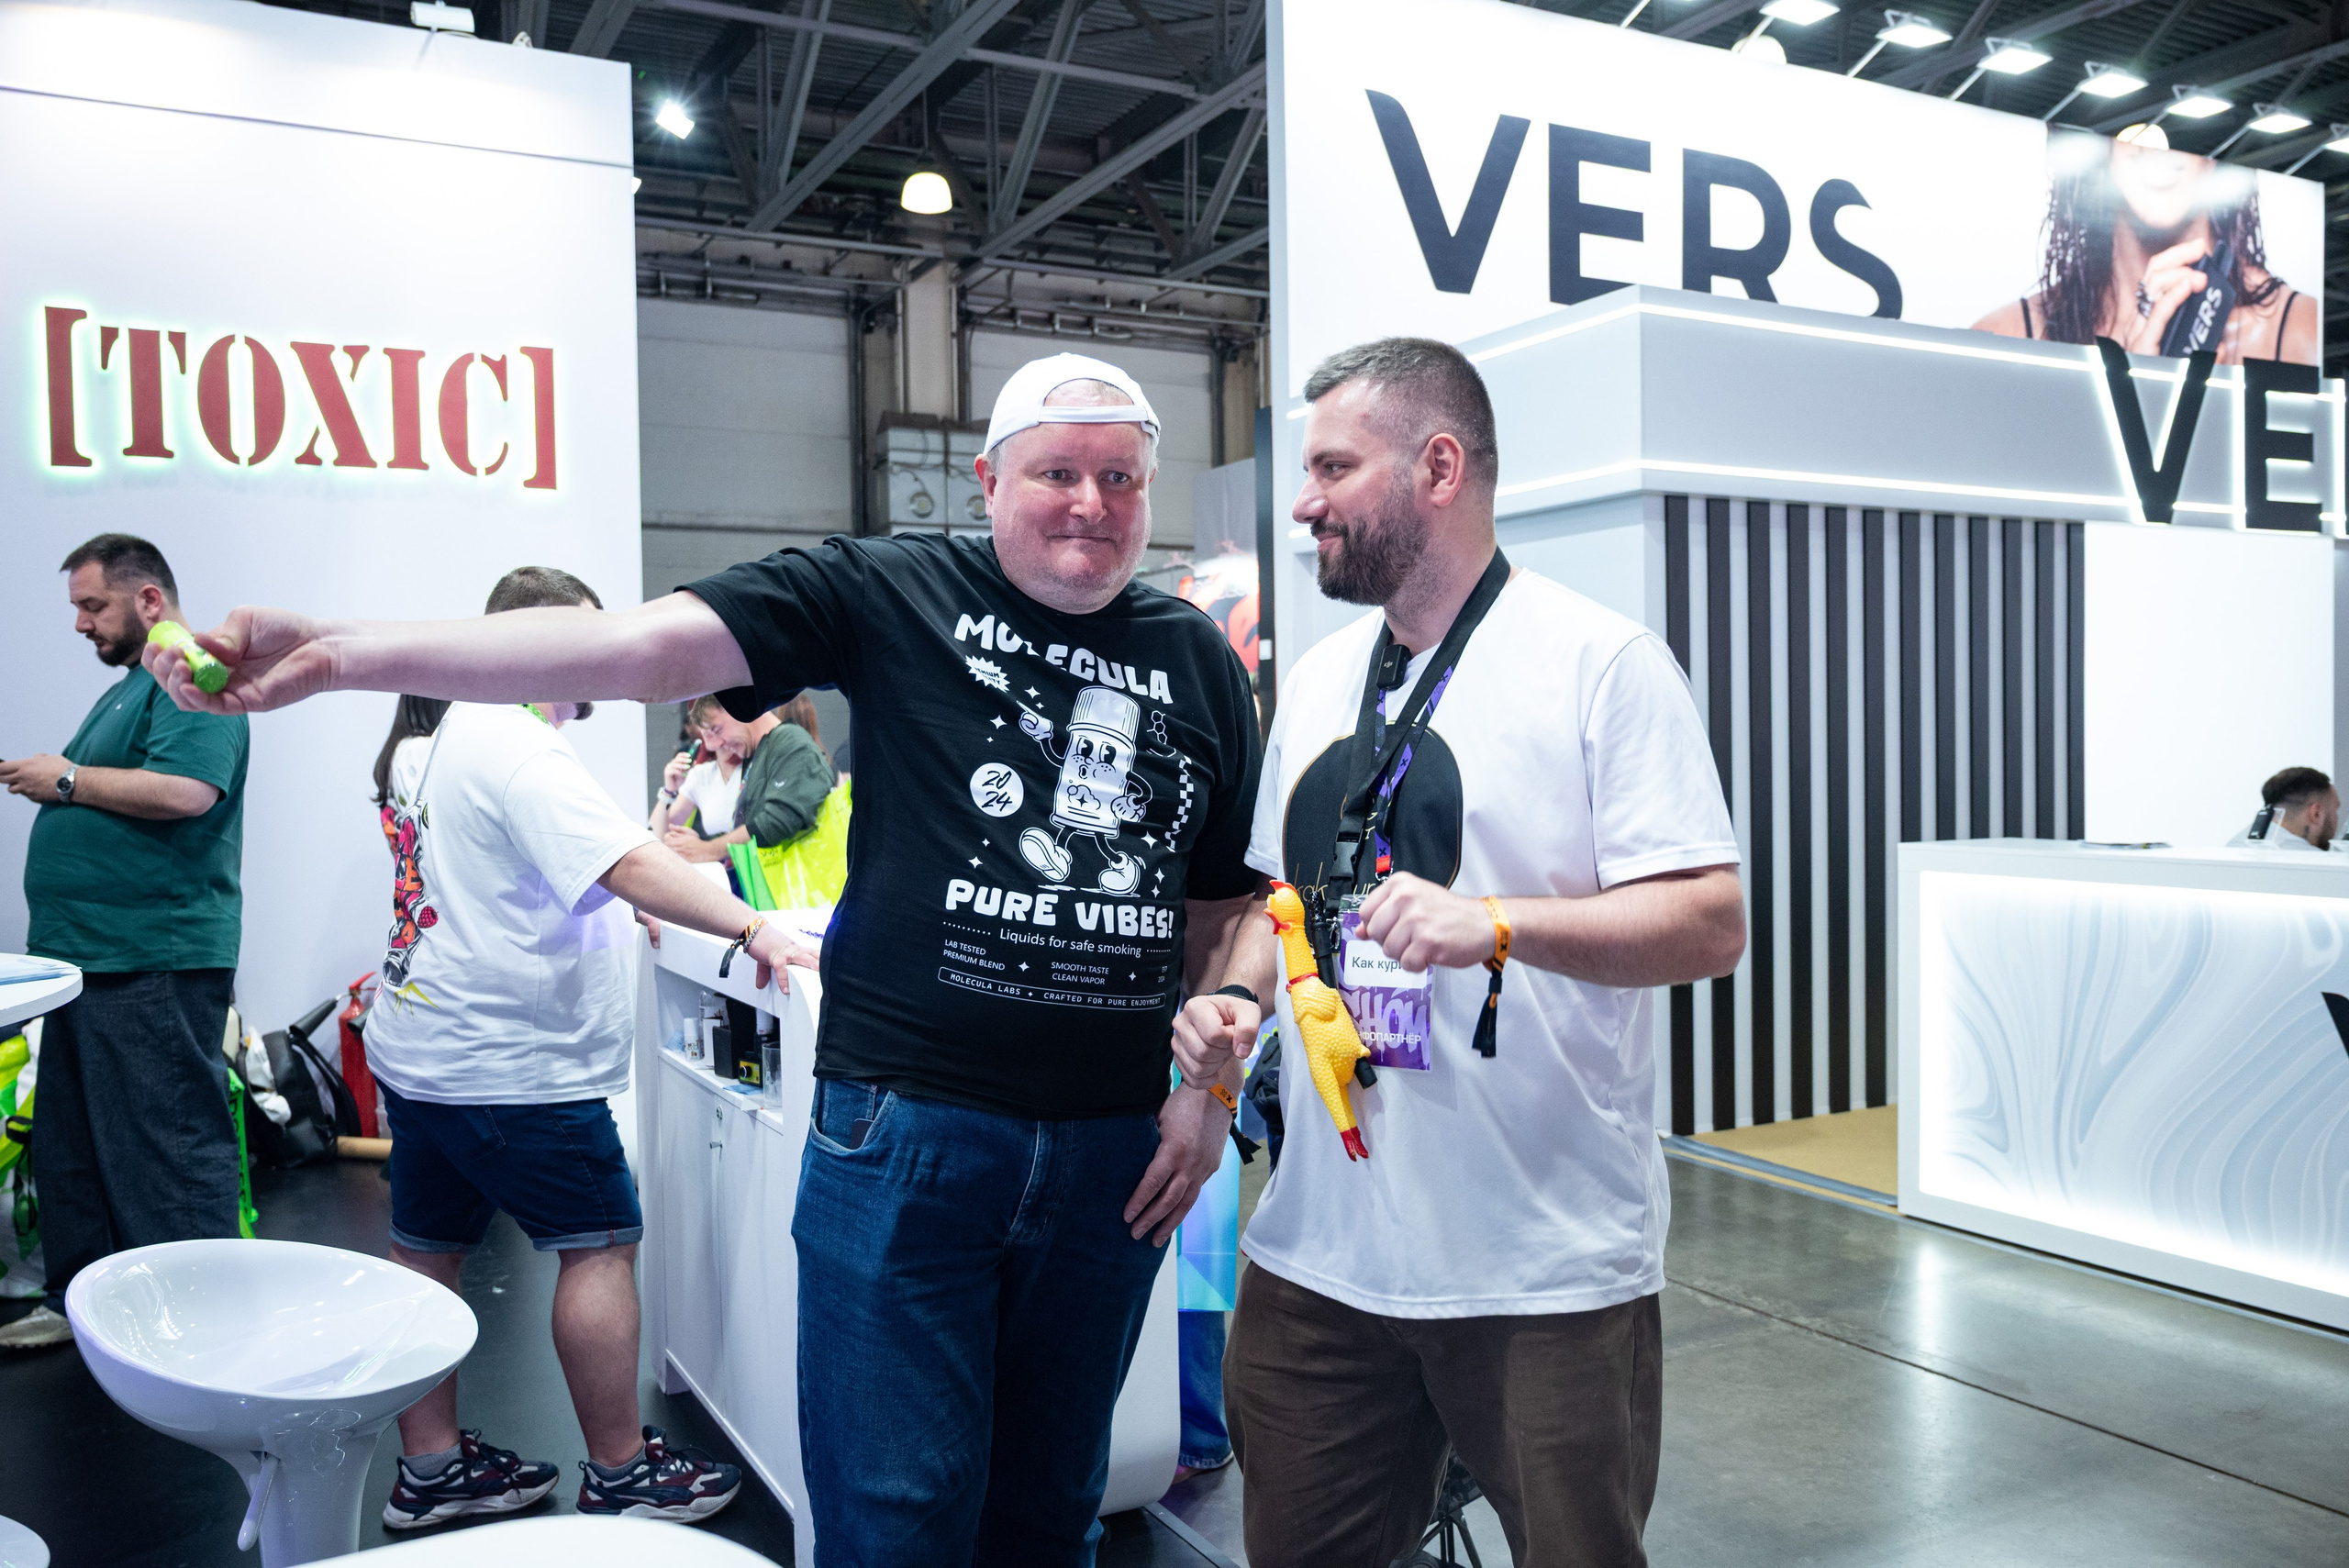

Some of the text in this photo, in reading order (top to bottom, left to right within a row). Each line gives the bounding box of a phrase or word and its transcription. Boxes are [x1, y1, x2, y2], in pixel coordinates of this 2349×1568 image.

[1364, 88, 1903, 320] VERS
[44, 306, 558, 490] [TOXIC]
[2096, 335, 2349, 536] VE
[982, 770, 1012, 790] 20
[981, 791, 1013, 812] 24
[945, 879, 1174, 939] PURE VIBES!
[944, 939, 986, 956] LAB TESTED
[1000, 928, 1141, 959] Liquids for safe smoking
[943, 949, 1006, 971] PREMIUM BLEND
[1051, 962, 1109, 975] SMOOTH TASTE
[1352, 956, 1375, 969] Как
[950, 973, 1161, 1006] MOLECULA LABS CRAFTED FOR PURE ENJOYMENT
[1052, 973, 1106, 985] CLEAN VAPOR
